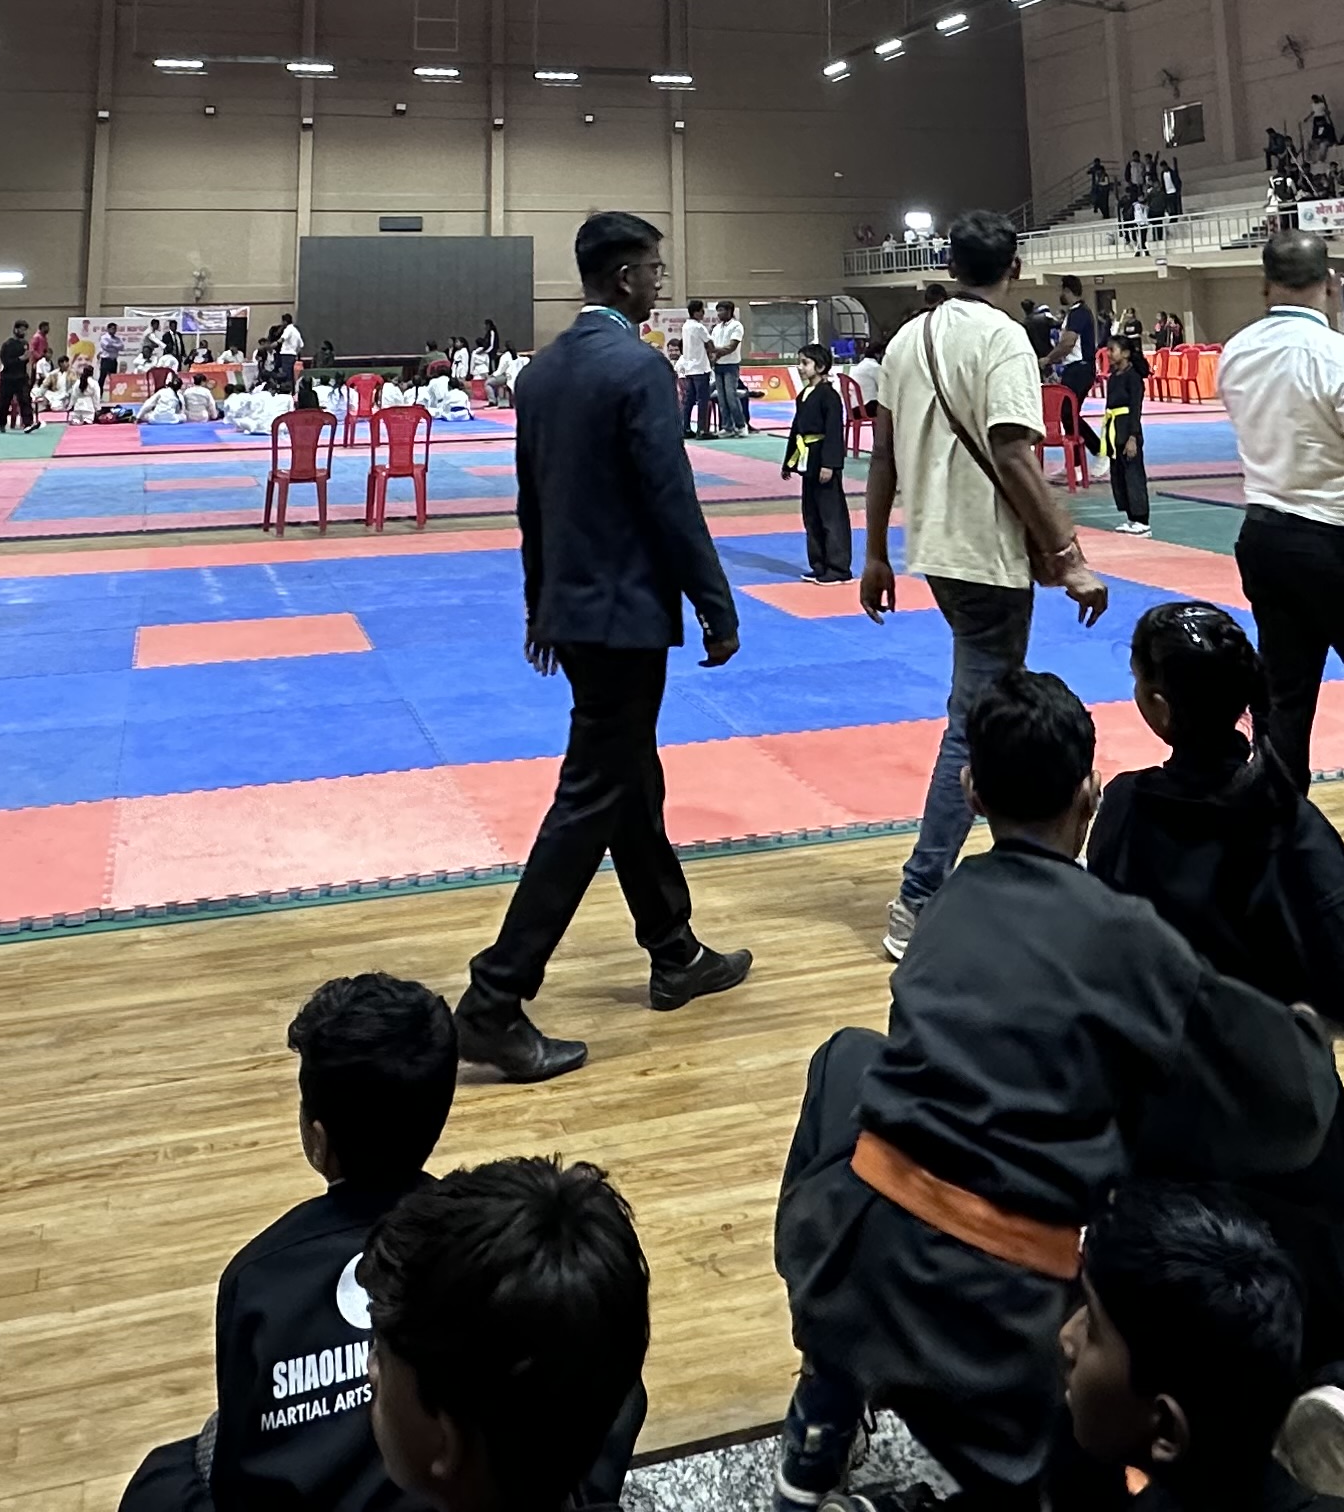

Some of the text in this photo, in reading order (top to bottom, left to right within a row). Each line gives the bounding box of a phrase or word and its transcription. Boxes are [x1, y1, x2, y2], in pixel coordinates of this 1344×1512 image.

[272, 1340, 369, 1400] SHAOLIN
[261, 1383, 373, 1432] MARTIAL ARTS
